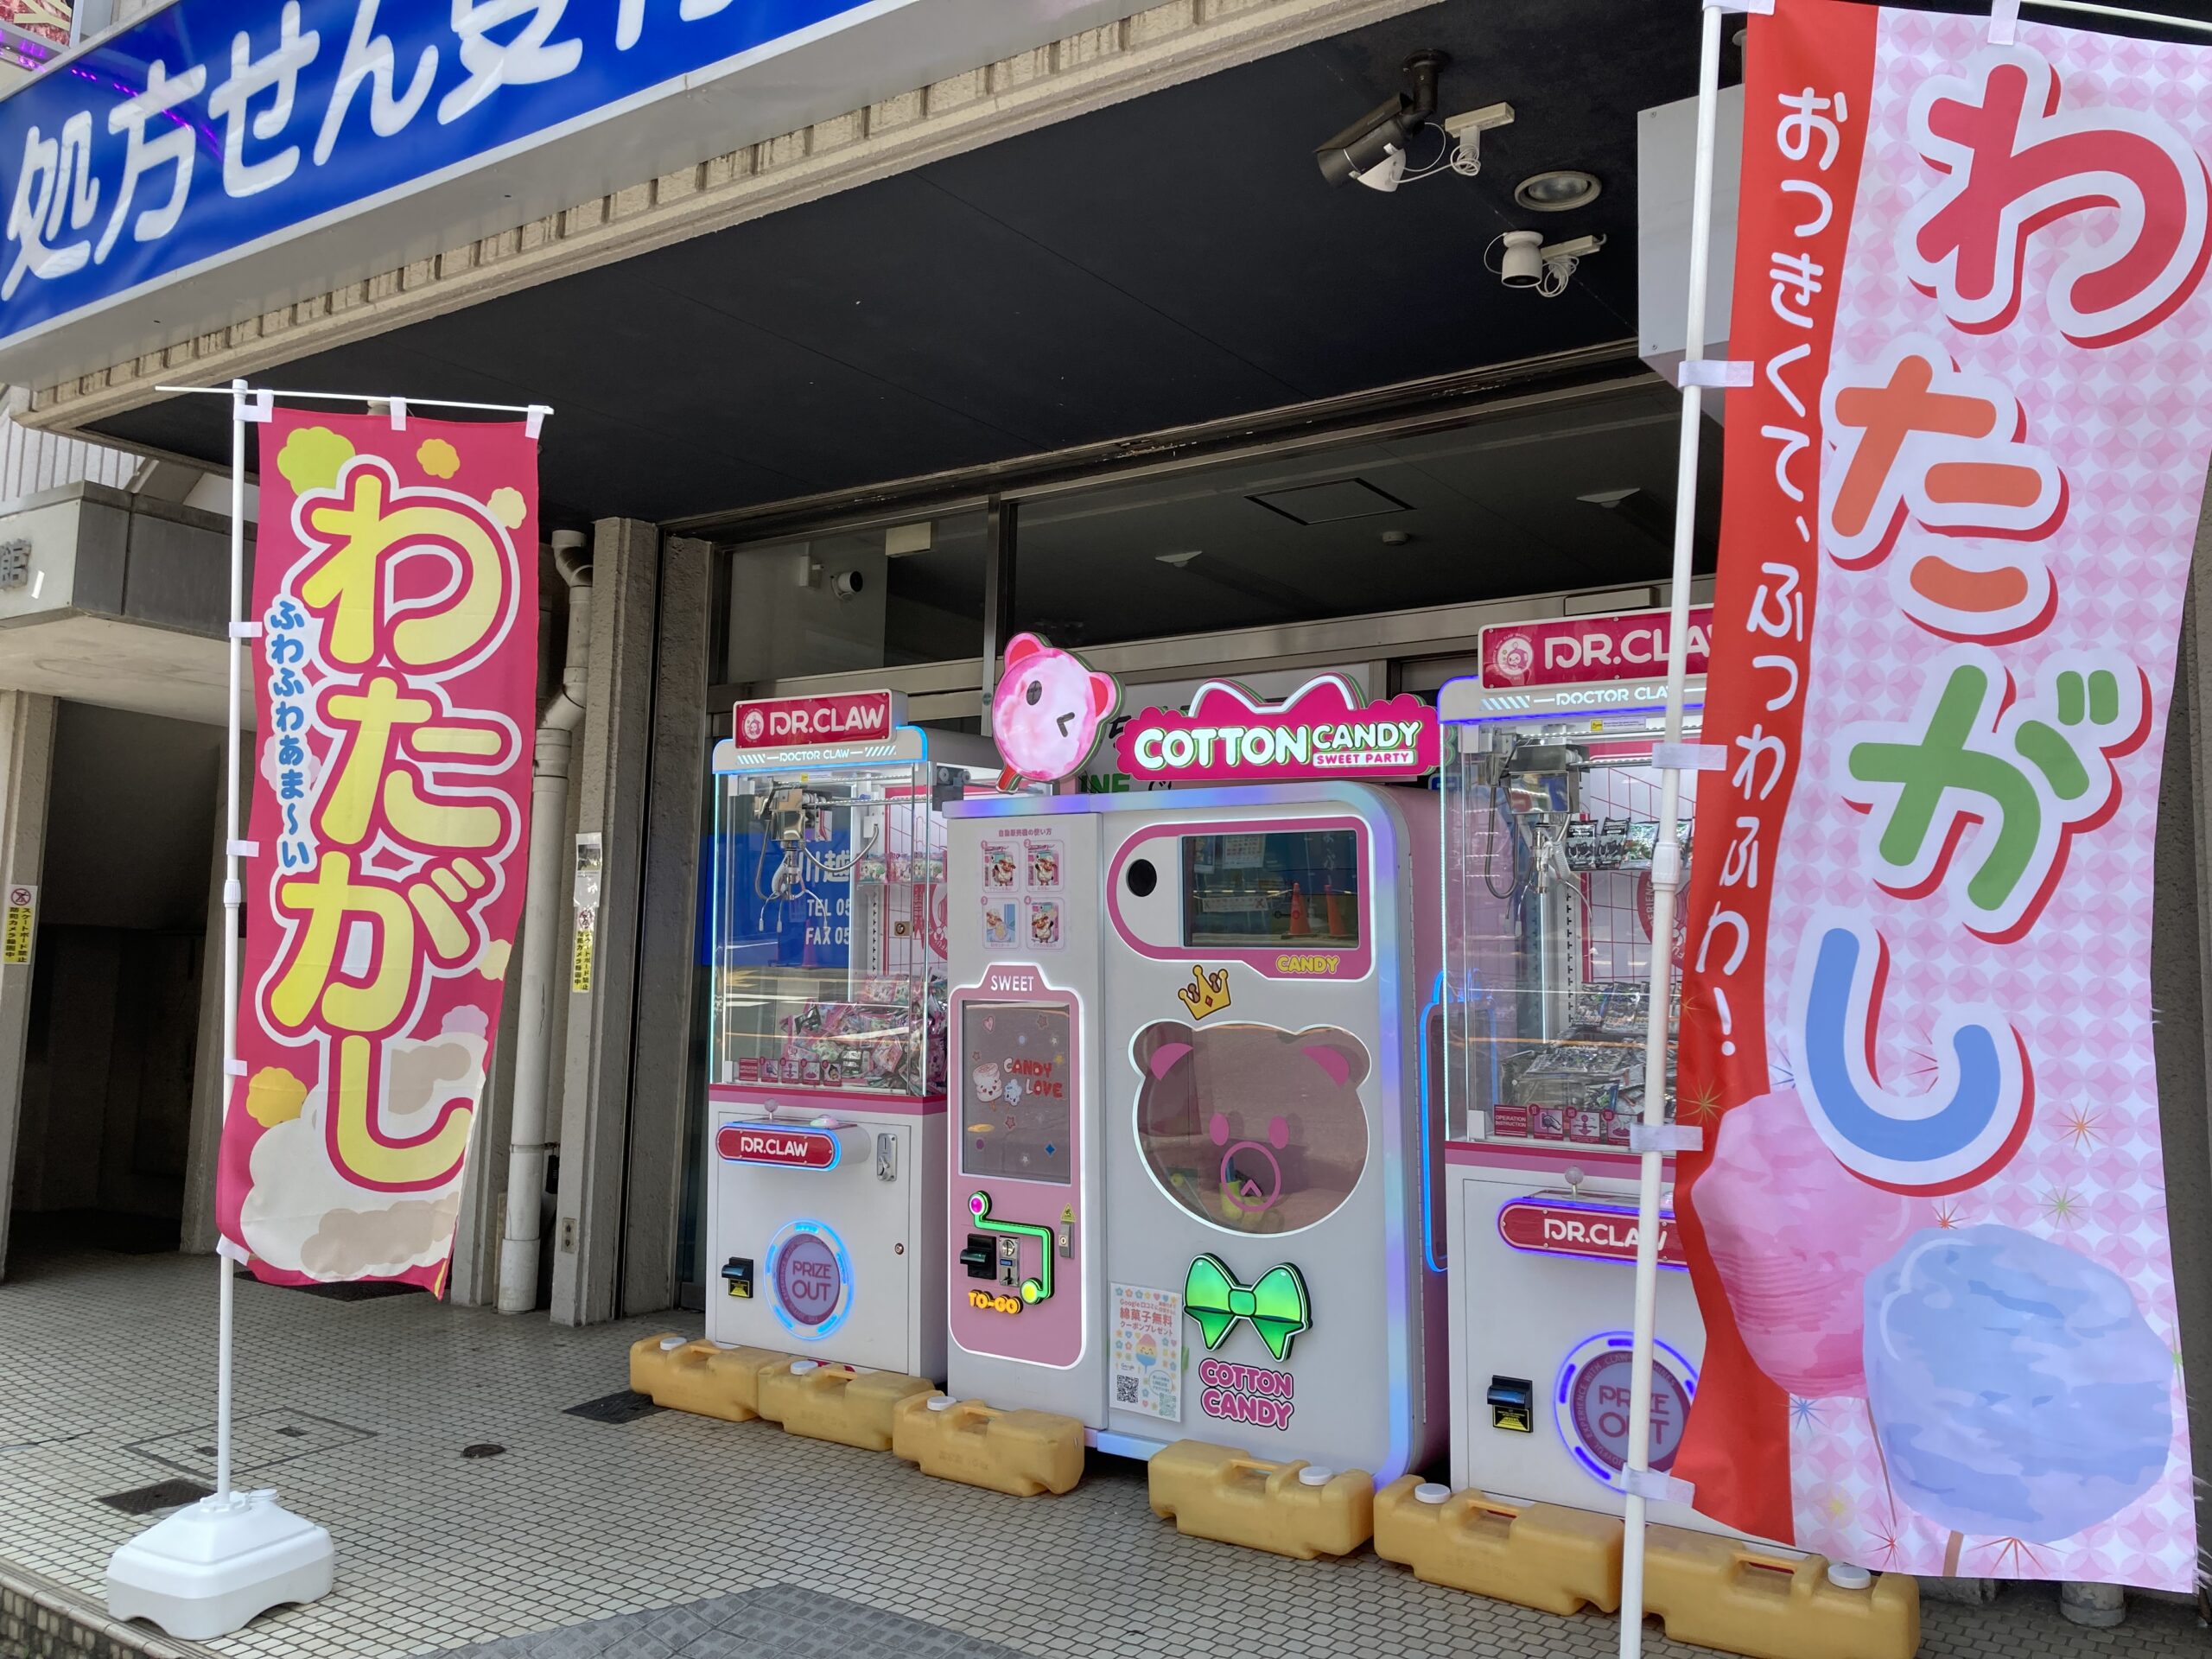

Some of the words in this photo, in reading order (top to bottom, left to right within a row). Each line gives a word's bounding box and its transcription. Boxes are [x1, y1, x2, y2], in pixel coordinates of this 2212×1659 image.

[1, 0, 734, 302] 処方せん受
[1804, 64, 2188, 1162] わたがし
[1544, 624, 1713, 671] DR.CLA
[1556, 688, 1629, 706] DOCTOR
[1634, 685, 1669, 701] CLA
[769, 703, 885, 736] DR.CLAW
[779, 750, 820, 762] DOCTOR
[823, 747, 849, 760] CLAW
[1133, 724, 1312, 770] COTTON
[1311, 721, 1422, 751] CANDY
[1316, 753, 1359, 765] SWEET
[1364, 752, 1409, 765] PARTY
[270, 474, 504, 1184] わたがし
[807, 898, 832, 917] TEL
[805, 926, 831, 945] FAX
[1276, 955, 1340, 974] CANDY
[990, 975, 1034, 992] SWEET
[1003, 1058, 1053, 1079] CANDY
[1026, 1077, 1063, 1099] LOVE
[741, 1135, 809, 1158] DR.CLAW
[792, 1260, 832, 1280] PRIZE
[791, 1279, 832, 1302] OUT
[967, 1289, 1022, 1314] TO-GO
[1198, 1357, 1294, 1400] COTTON
[1201, 1387, 1294, 1432] CANDY
[1599, 1411, 1670, 1446] OT
